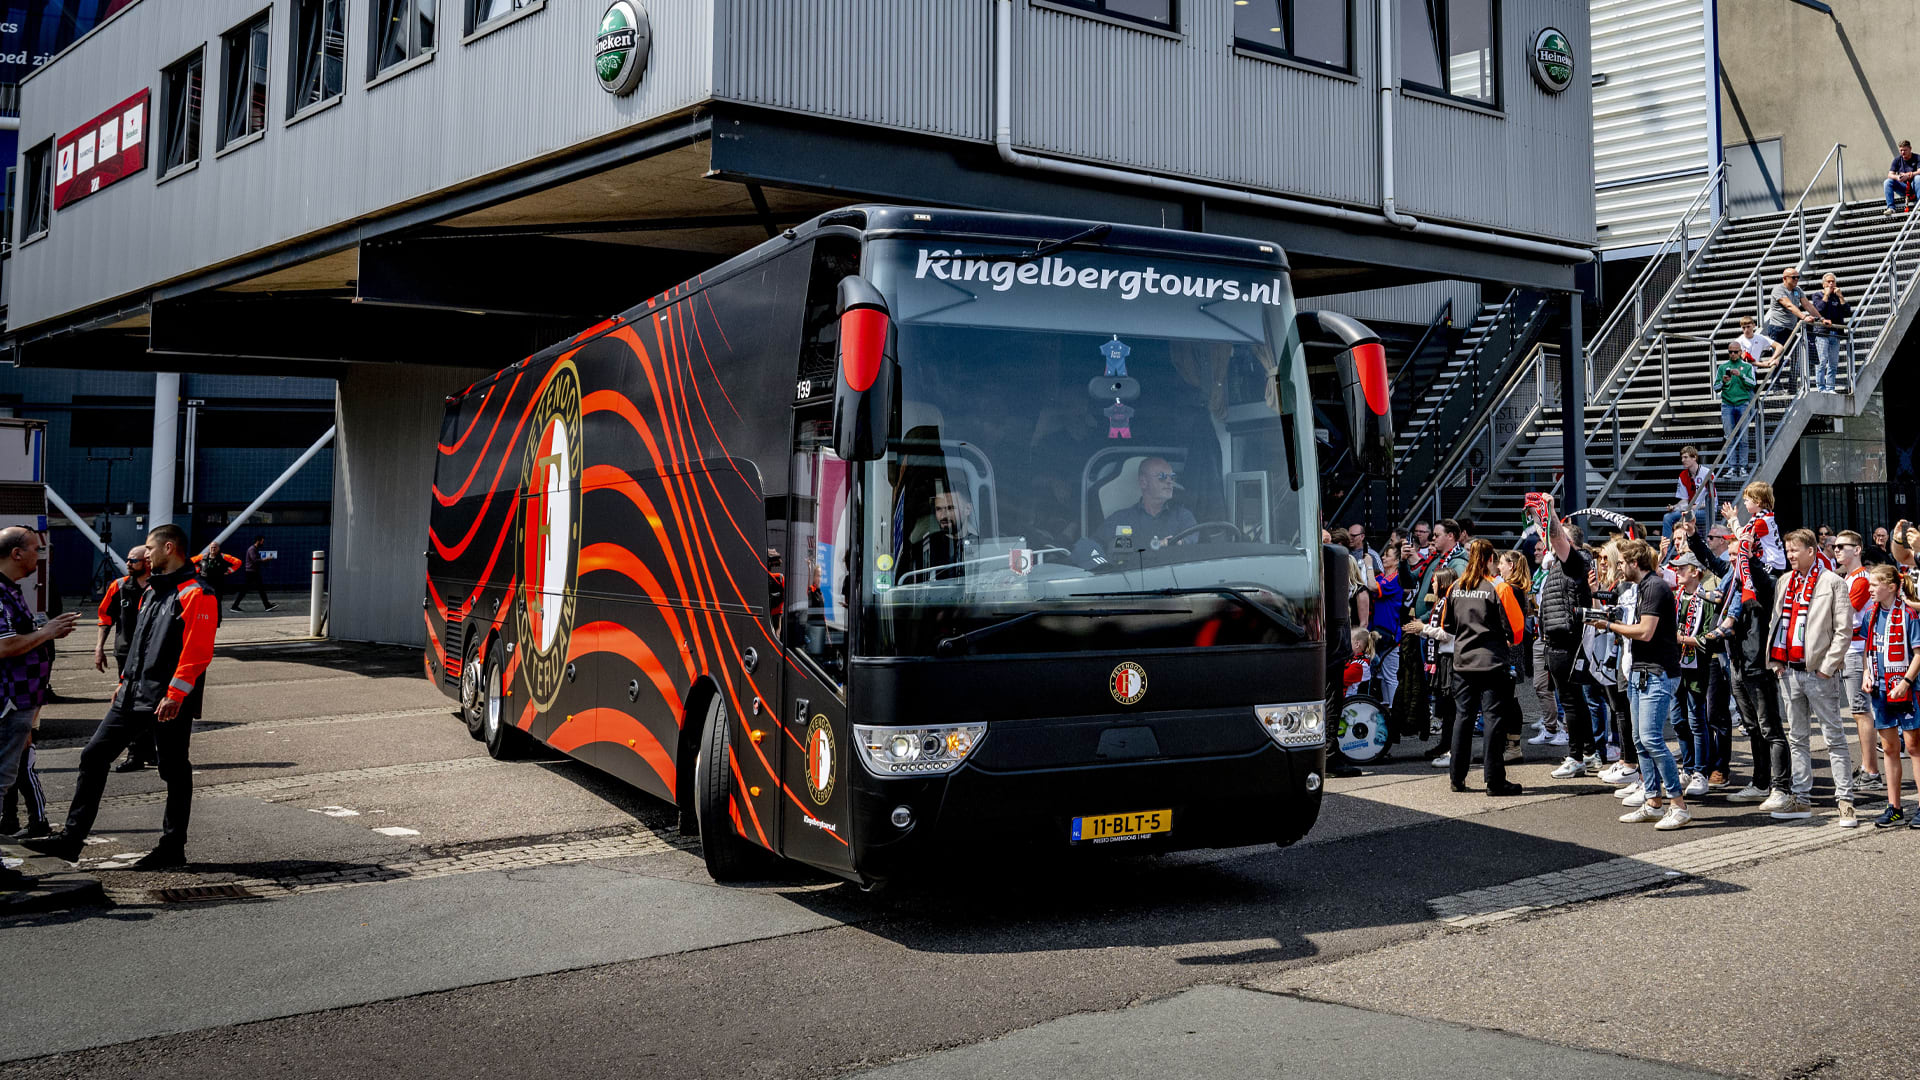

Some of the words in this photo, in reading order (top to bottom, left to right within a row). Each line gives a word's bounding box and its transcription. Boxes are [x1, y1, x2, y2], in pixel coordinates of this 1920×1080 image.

[0, 22, 18, 33] cs
[595, 35, 631, 55] ineken
[32, 52, 55, 66] zi
[1540, 50, 1571, 65] Heine
[915, 249, 1281, 306] Kingelbergtours.nl
[797, 380, 811, 399] 159
[524, 374, 580, 488] FEYENOORD
[1452, 589, 1490, 599] SECURITY
[1112, 663, 1145, 678] FEYENOORD
[807, 718, 835, 749] FEYENOORD
[1093, 813, 1161, 836] 11-BLT-5
